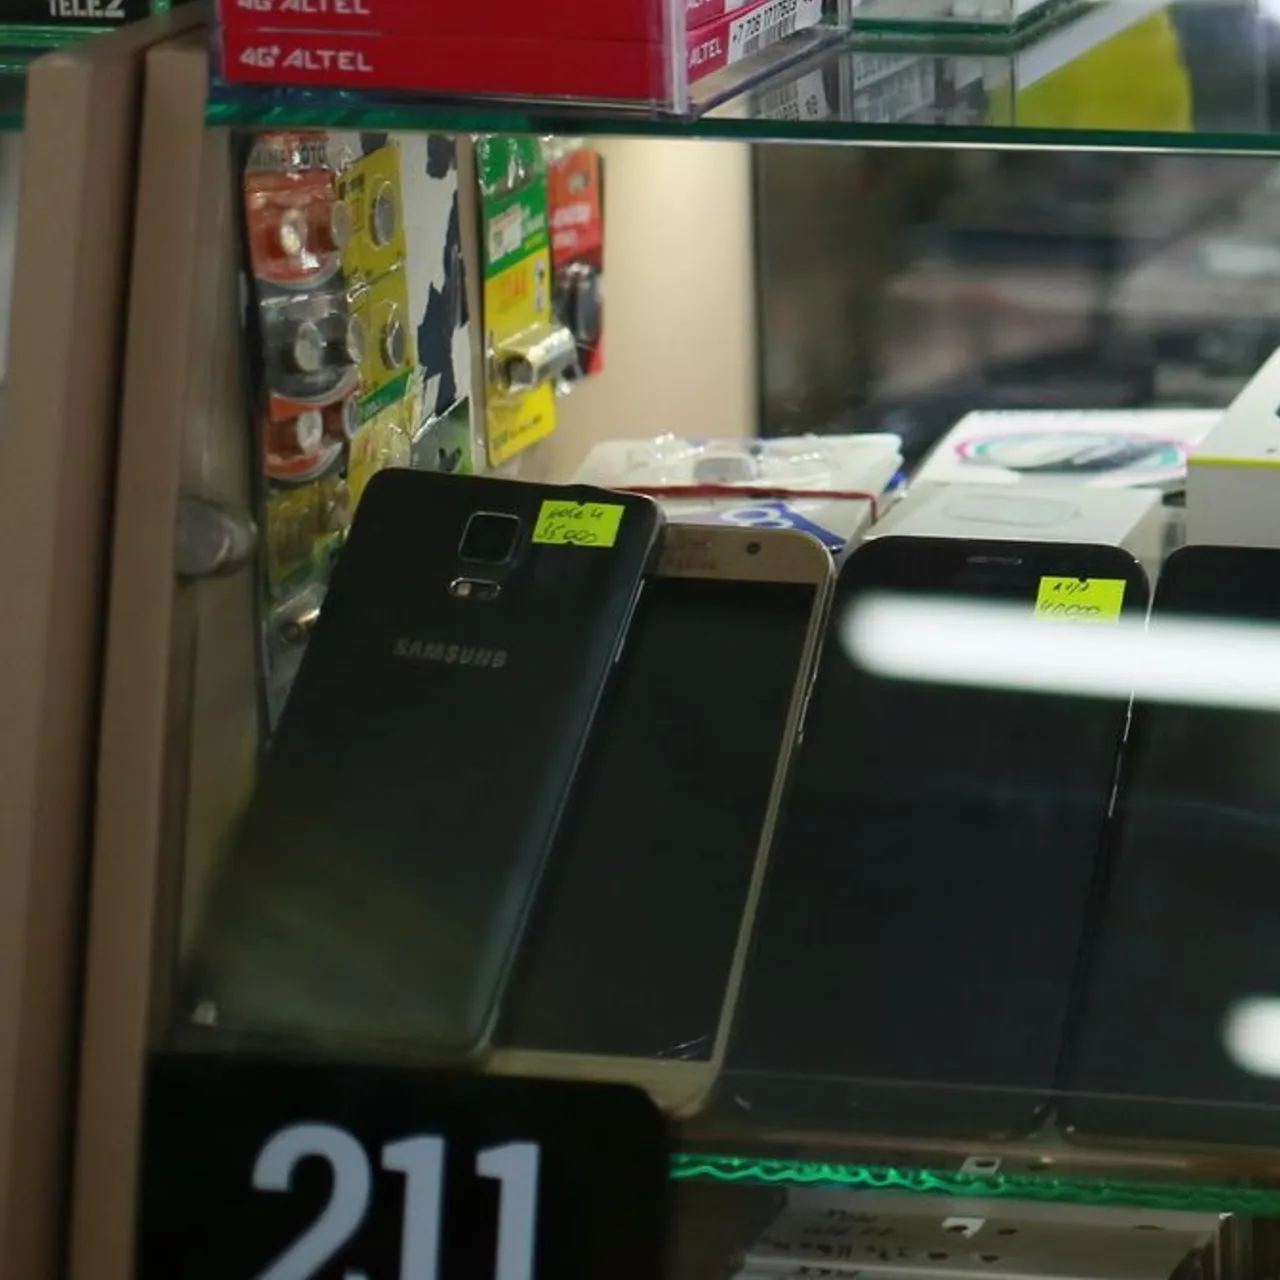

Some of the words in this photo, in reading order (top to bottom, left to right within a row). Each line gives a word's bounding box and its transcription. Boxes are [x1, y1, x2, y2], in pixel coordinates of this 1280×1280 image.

[283, 48, 374, 72] ALTEL
[688, 37, 723, 68] ALTEL
[392, 637, 508, 668] SAMSUNG
[250, 1121, 541, 1280] 211
